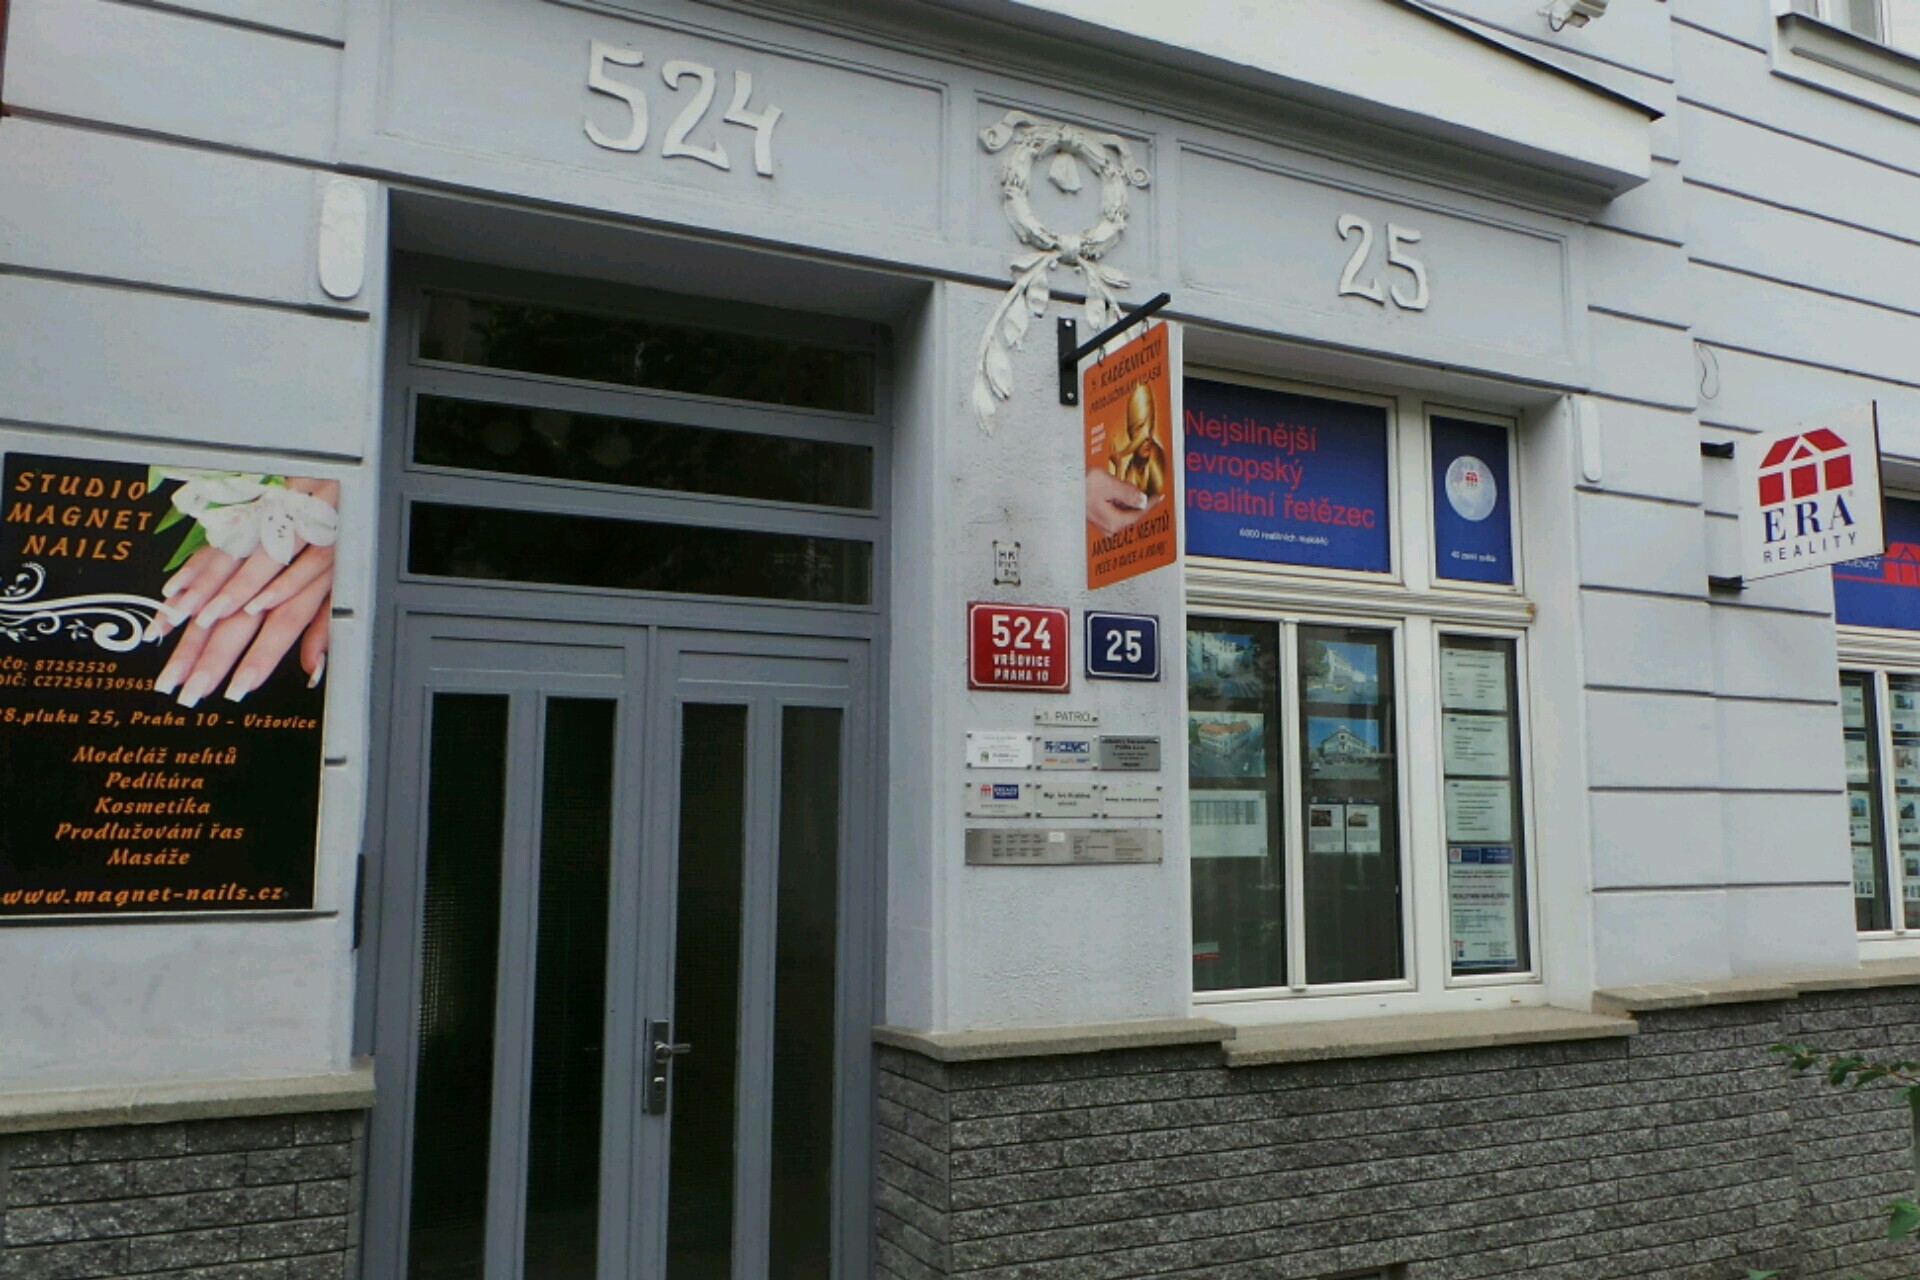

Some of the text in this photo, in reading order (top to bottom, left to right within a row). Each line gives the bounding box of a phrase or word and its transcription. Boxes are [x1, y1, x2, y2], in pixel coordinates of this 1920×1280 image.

[583, 38, 784, 178] 524
[1336, 213, 1429, 312] 25
[1185, 409, 1318, 455] Nejsilnější
[1185, 450, 1303, 490] evropský
[15, 471, 147, 500] STUDIO
[6, 501, 153, 531] MAGNET
[1186, 485, 1376, 529] realitní řetězec
[1762, 494, 1855, 544] ERA
[22, 534, 133, 560] NAILS
[1764, 531, 1857, 563] REALITY
[991, 613, 1052, 651] 524
[993, 650, 1051, 668] VRŠOVICE
[1106, 629, 1142, 663] 25
[0, 656, 119, 674] ČO: 87252520
[994, 667, 1050, 683] PRAHA 10
[0, 706, 80, 726] 8.pluku
[88, 708, 120, 727] 25,
[130, 710, 186, 727] Praha
[195, 712, 220, 727] 10
[242, 713, 318, 730] Vršovice
[1055, 711, 1091, 723] PATRO
[72, 745, 238, 766] Modeláž nehtů
[105, 770, 205, 790] Pedikúra
[94, 796, 211, 815] Kosmetika
[54, 822, 245, 841] Prodlužování řas
[106, 848, 191, 867] Masáže
[1, 882, 284, 907] www.magnet-nails.cz
